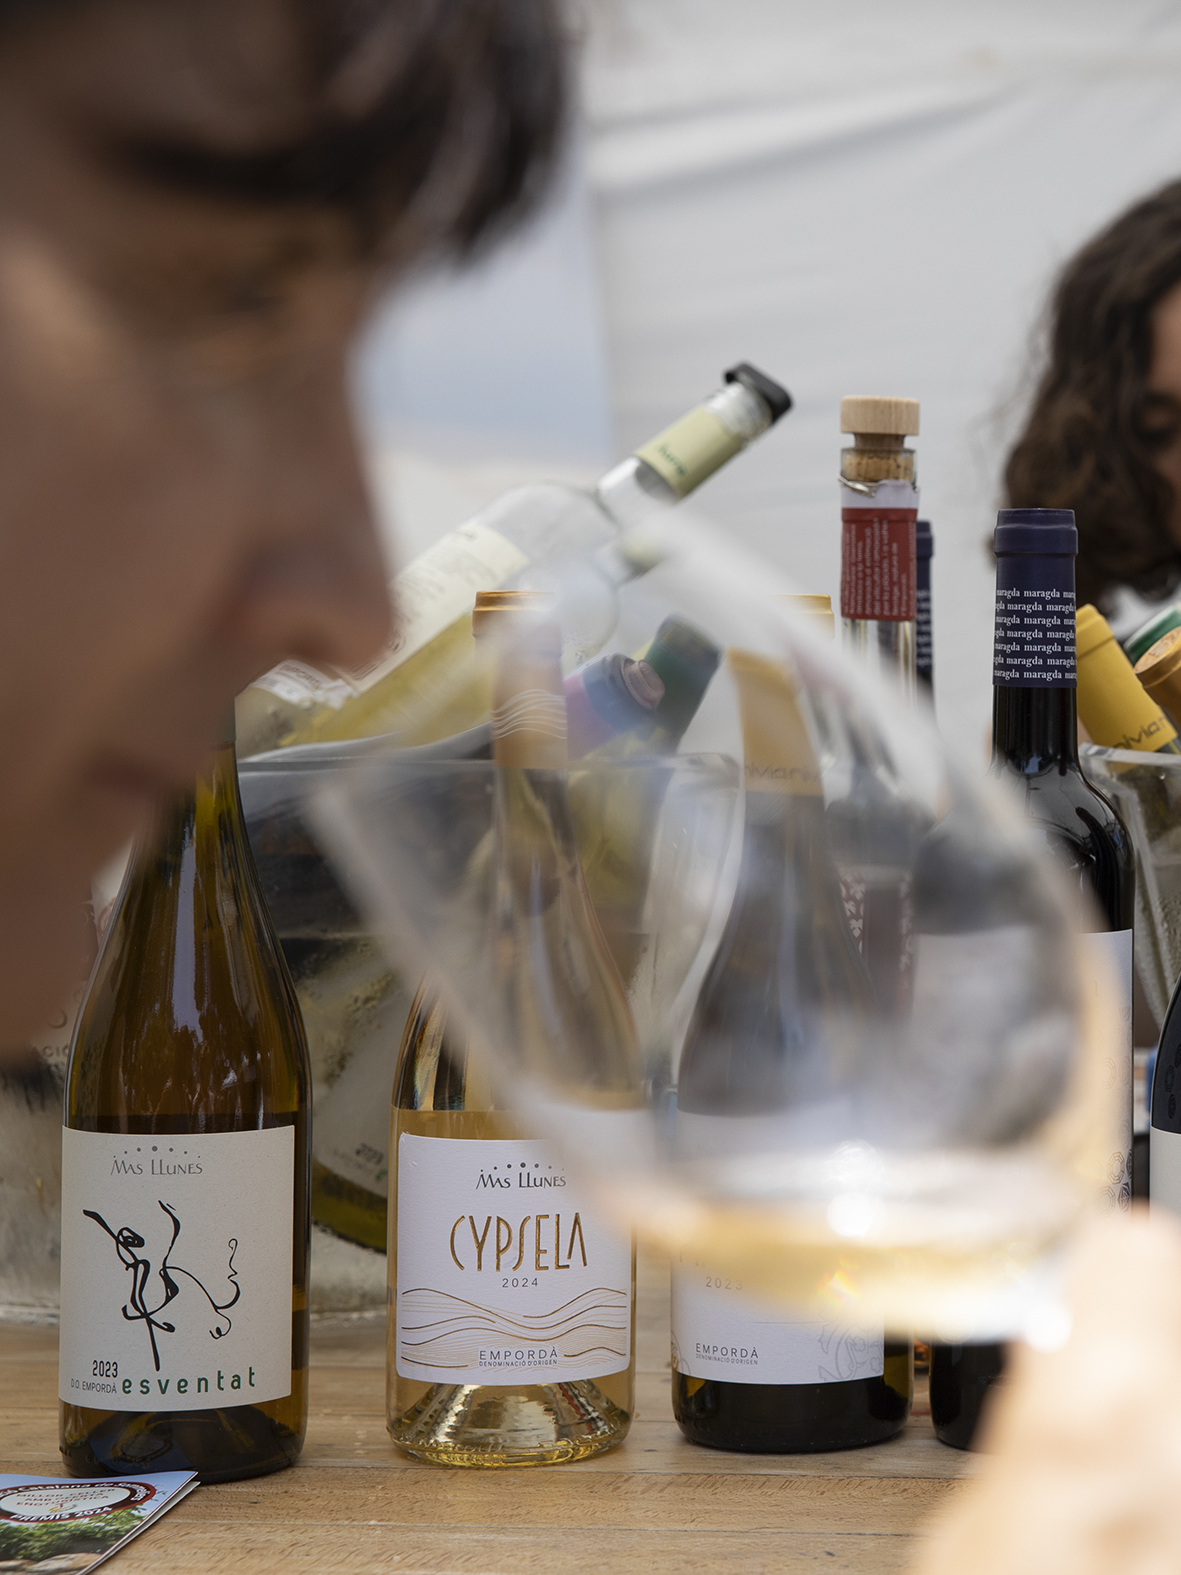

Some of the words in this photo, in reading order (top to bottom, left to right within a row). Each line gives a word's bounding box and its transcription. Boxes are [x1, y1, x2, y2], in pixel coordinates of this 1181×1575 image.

[1024, 588, 1060, 600] maragda
[1007, 602, 1042, 613] maragda
[1024, 616, 1061, 627] maragda
[1007, 629, 1042, 641] maragda
[1024, 643, 1061, 654] maragda
[1006, 656, 1042, 667] maragda
[1023, 670, 1062, 681] maragda
[450, 1212, 587, 1272] CYPSELA
[502, 1278, 538, 1288] 2024
[705, 1276, 743, 1291] 2023
[479, 1346, 557, 1360] EMPORDÀ
[696, 1343, 758, 1358] EMPORDÀ
[92, 1360, 118, 1378] 2023
[70, 1378, 81, 1390] D.O.
[82, 1381, 117, 1394] EMPORDÀ
[122, 1366, 255, 1395] esventat
